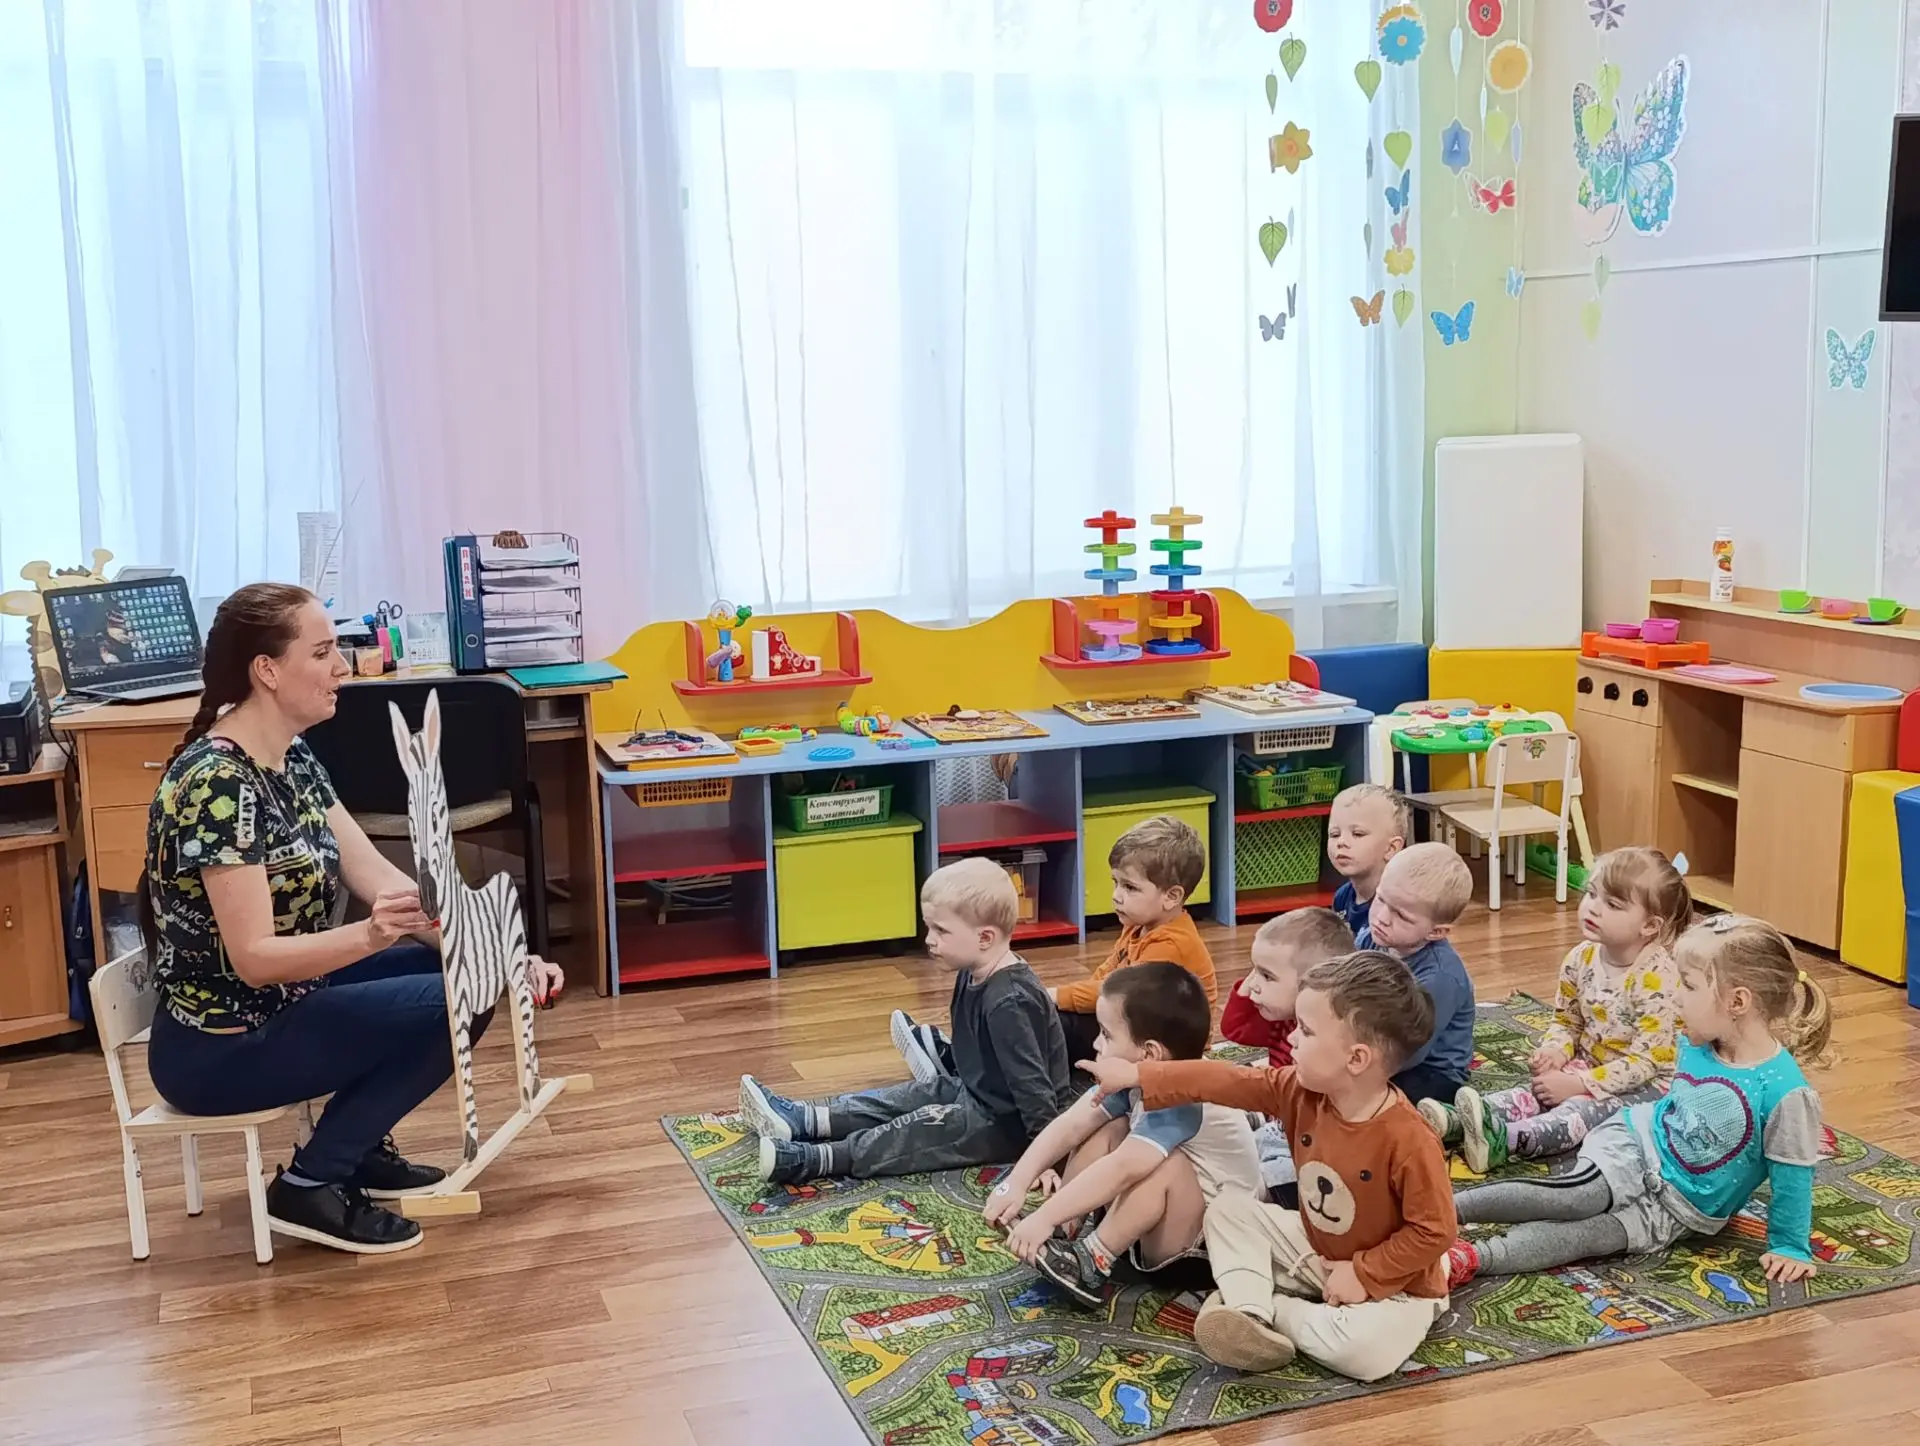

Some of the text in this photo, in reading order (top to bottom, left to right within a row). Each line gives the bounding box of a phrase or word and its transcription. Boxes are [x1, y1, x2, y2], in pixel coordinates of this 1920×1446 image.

[809, 794, 876, 809] Конструктор
[809, 807, 866, 821] магнитный
[170, 899, 212, 931] DANCE
